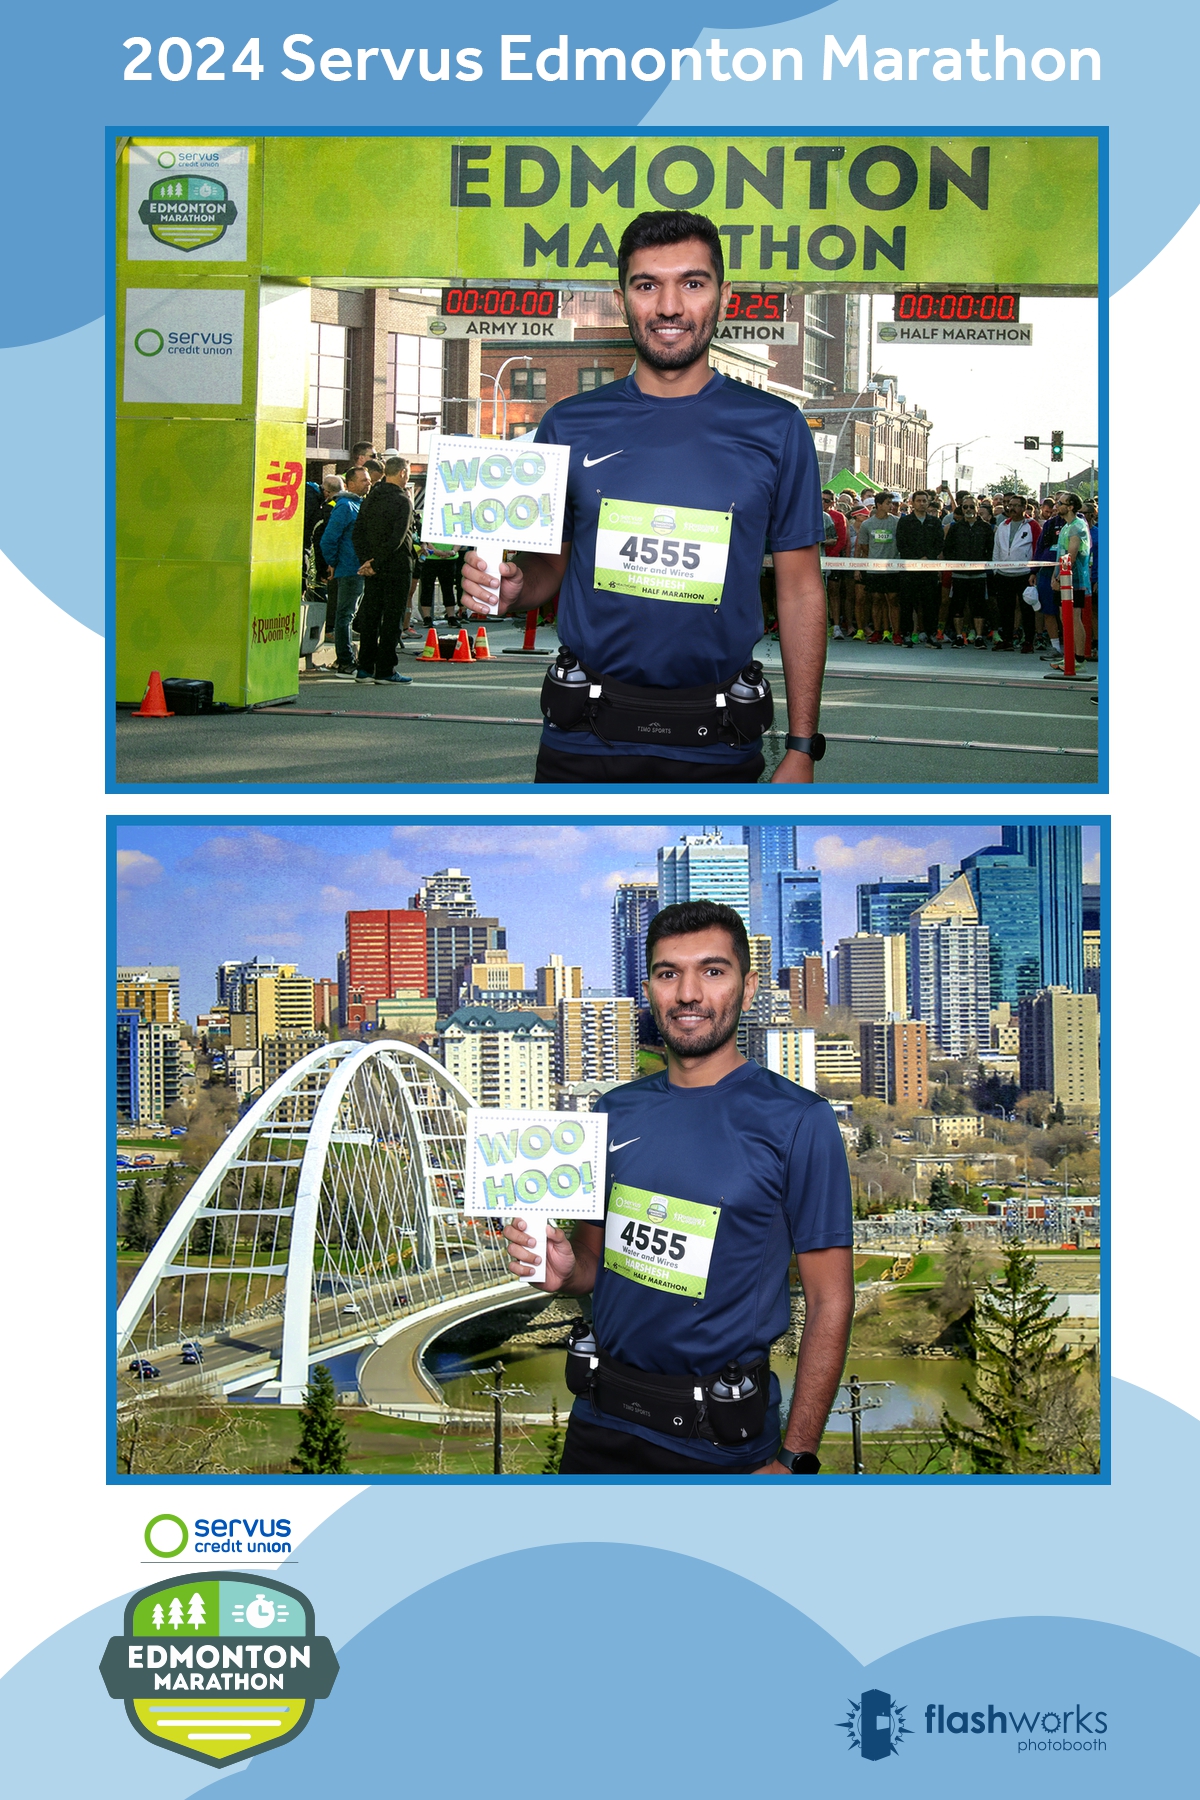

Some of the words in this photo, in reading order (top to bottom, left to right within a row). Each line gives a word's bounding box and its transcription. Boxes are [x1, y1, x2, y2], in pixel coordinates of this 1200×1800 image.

[178, 152, 220, 161] servus
[450, 144, 990, 211] EDMONTON
[149, 203, 227, 214] EDMONTON
[160, 214, 215, 222] MARATHON
[523, 222, 906, 271] MATHON
[168, 332, 233, 345] servus
[466, 321, 518, 336] ARMY
[522, 322, 554, 337] 10K
[900, 328, 939, 340] HALF
[943, 328, 1031, 341] MARATHON
[168, 345, 200, 355] credit
[202, 347, 233, 355] union
[438, 451, 546, 493] WOO
[441, 493, 552, 537] HOO!
[619, 535, 701, 570] 4555
[623, 562, 648, 573] Water
[650, 565, 667, 576] and
[670, 567, 695, 579] Wires
[627, 574, 686, 591] HARSHESH
[642, 587, 660, 596] HALF
[661, 589, 705, 600] MARATHON
[257, 613, 291, 640] Running
[477, 1120, 586, 1167] WOO
[483, 1161, 595, 1210] HOO!
[620, 1221, 688, 1261] 4555
[622, 1245, 640, 1257] Water
[641, 1253, 655, 1263] and
[657, 1256, 679, 1269] Wires
[625, 1258, 670, 1280] HARSHESH
[633, 1271, 648, 1281] HALF
[647, 1276, 688, 1292] MARATHON
